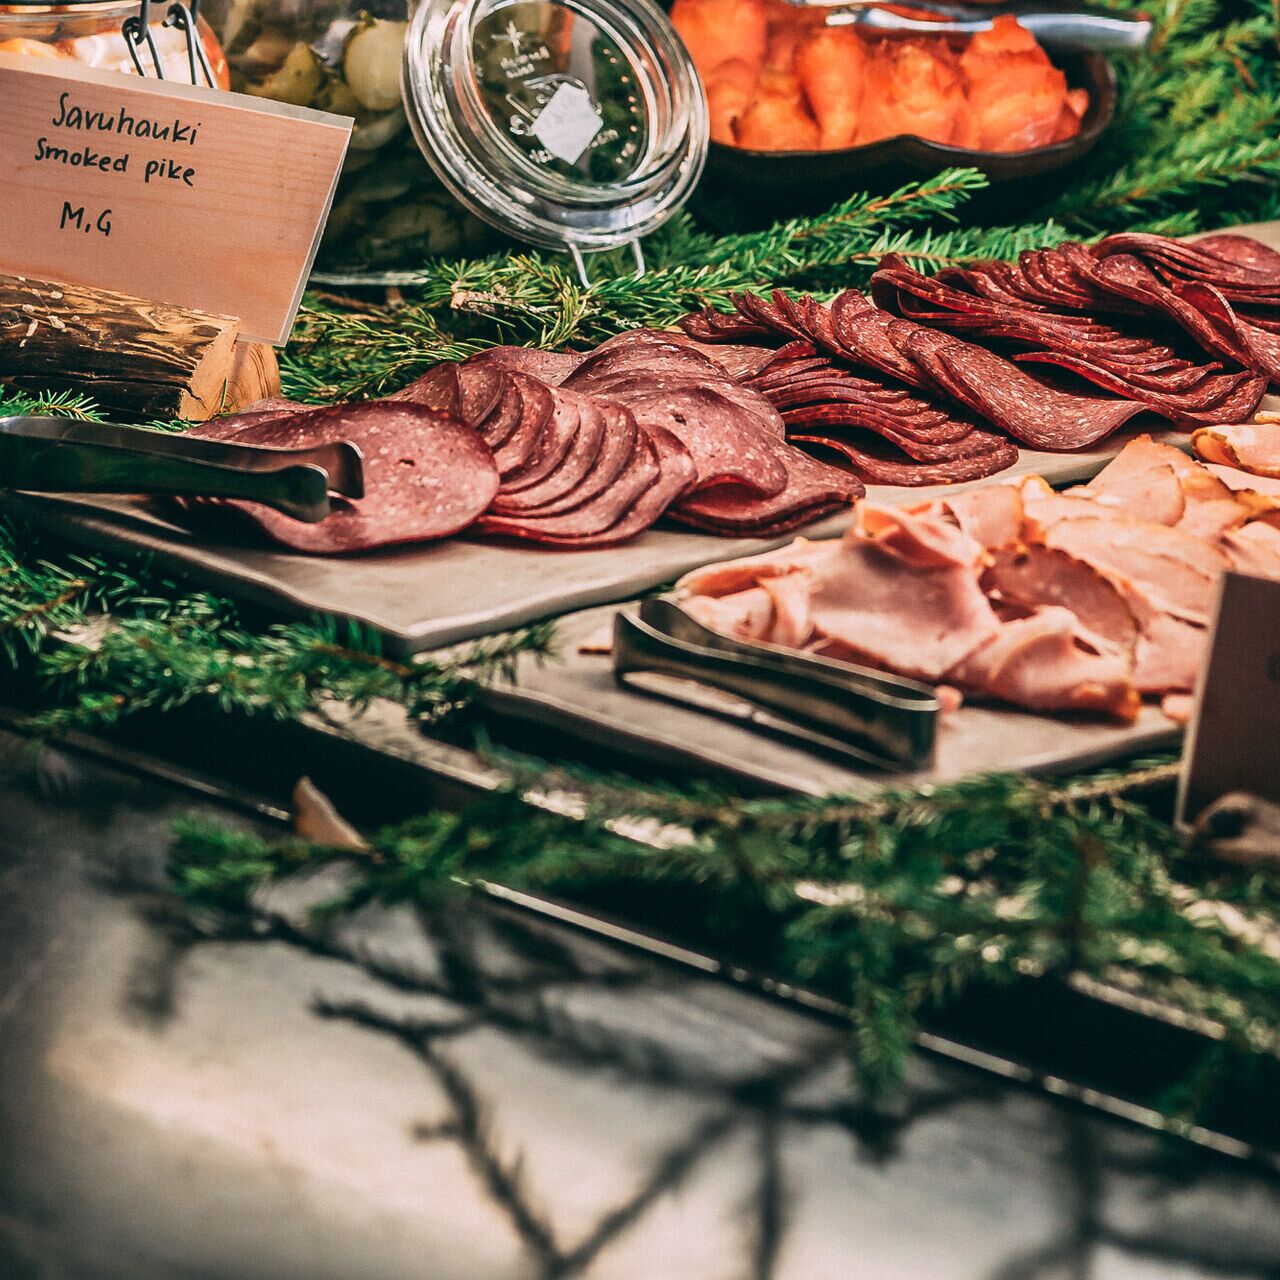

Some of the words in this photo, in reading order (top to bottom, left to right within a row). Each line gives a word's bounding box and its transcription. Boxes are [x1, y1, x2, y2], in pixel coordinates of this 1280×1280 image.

[52, 92, 202, 146] Savuhauki
[34, 137, 129, 173] Smoked
[144, 158, 196, 187] pike
